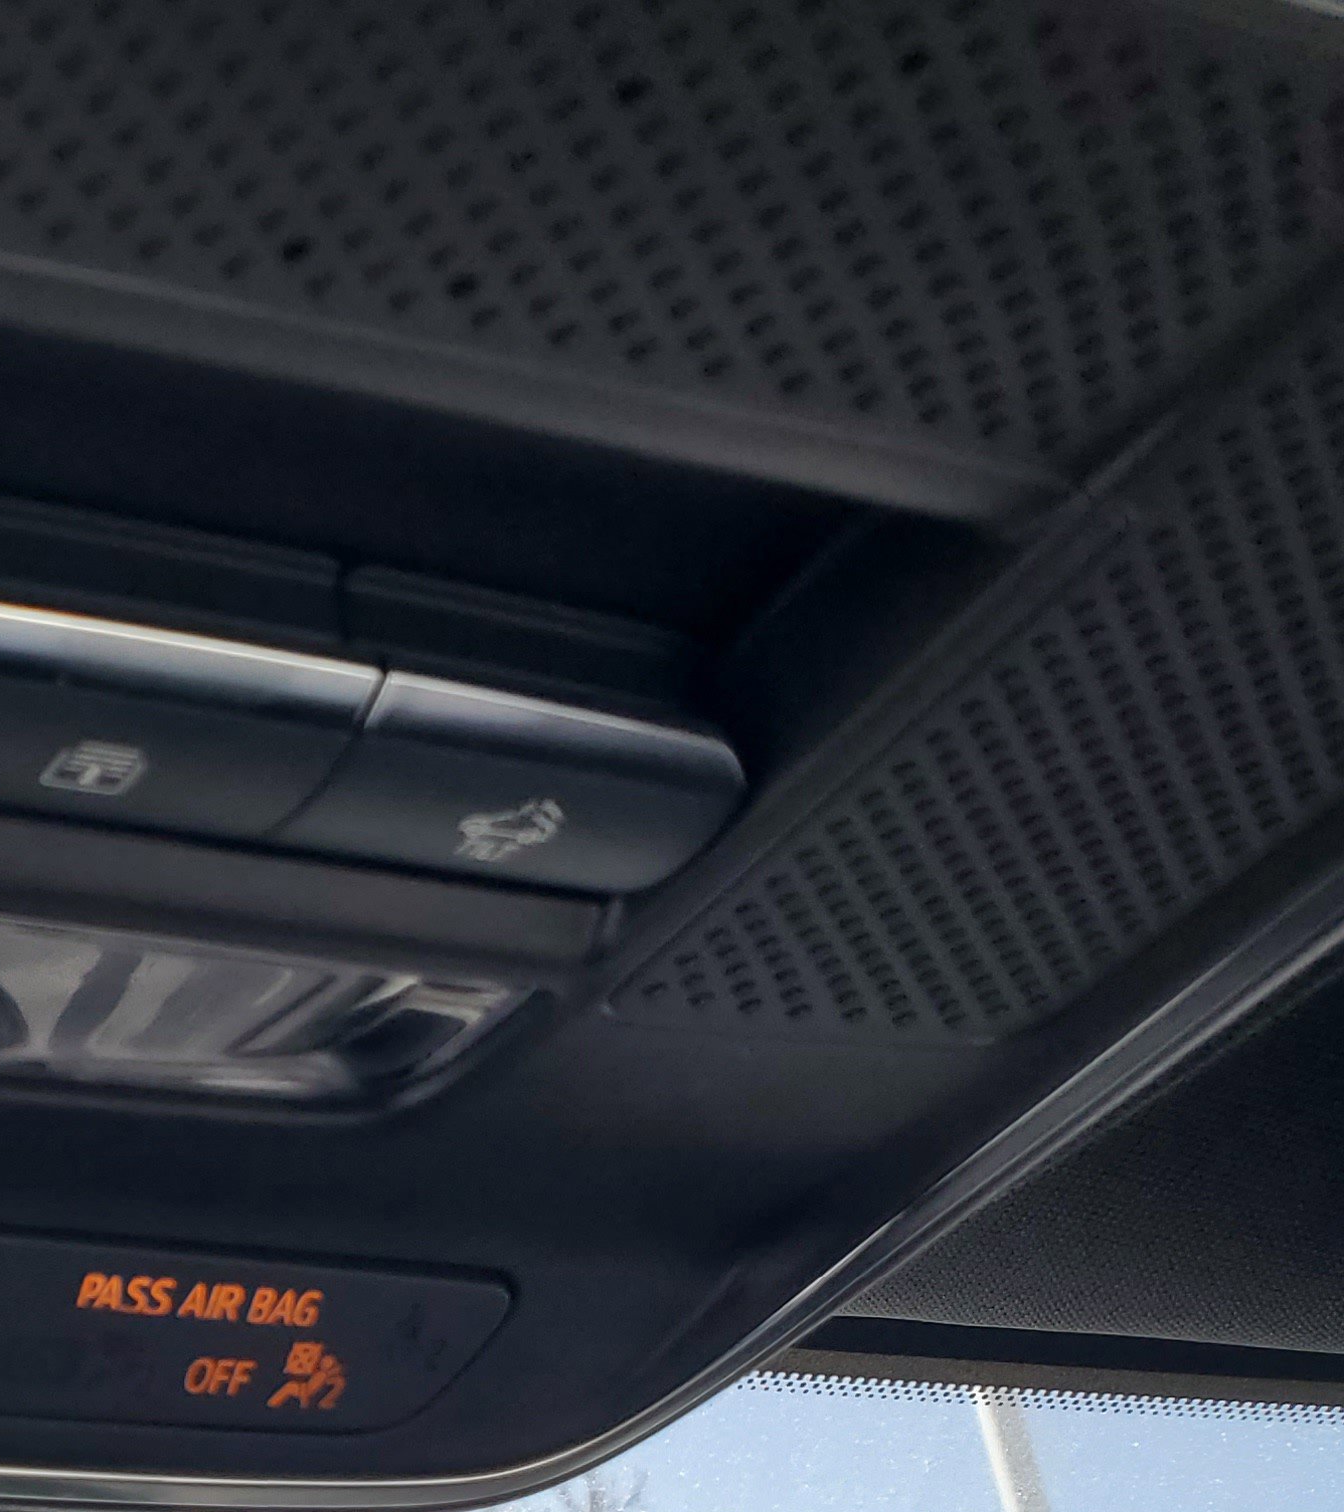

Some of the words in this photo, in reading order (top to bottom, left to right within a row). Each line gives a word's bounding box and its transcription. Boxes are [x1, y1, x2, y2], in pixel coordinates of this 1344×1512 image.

[76, 1271, 178, 1316] PASS
[176, 1281, 247, 1322] AIR
[245, 1286, 324, 1327] BAG
[183, 1356, 259, 1396] OFF
